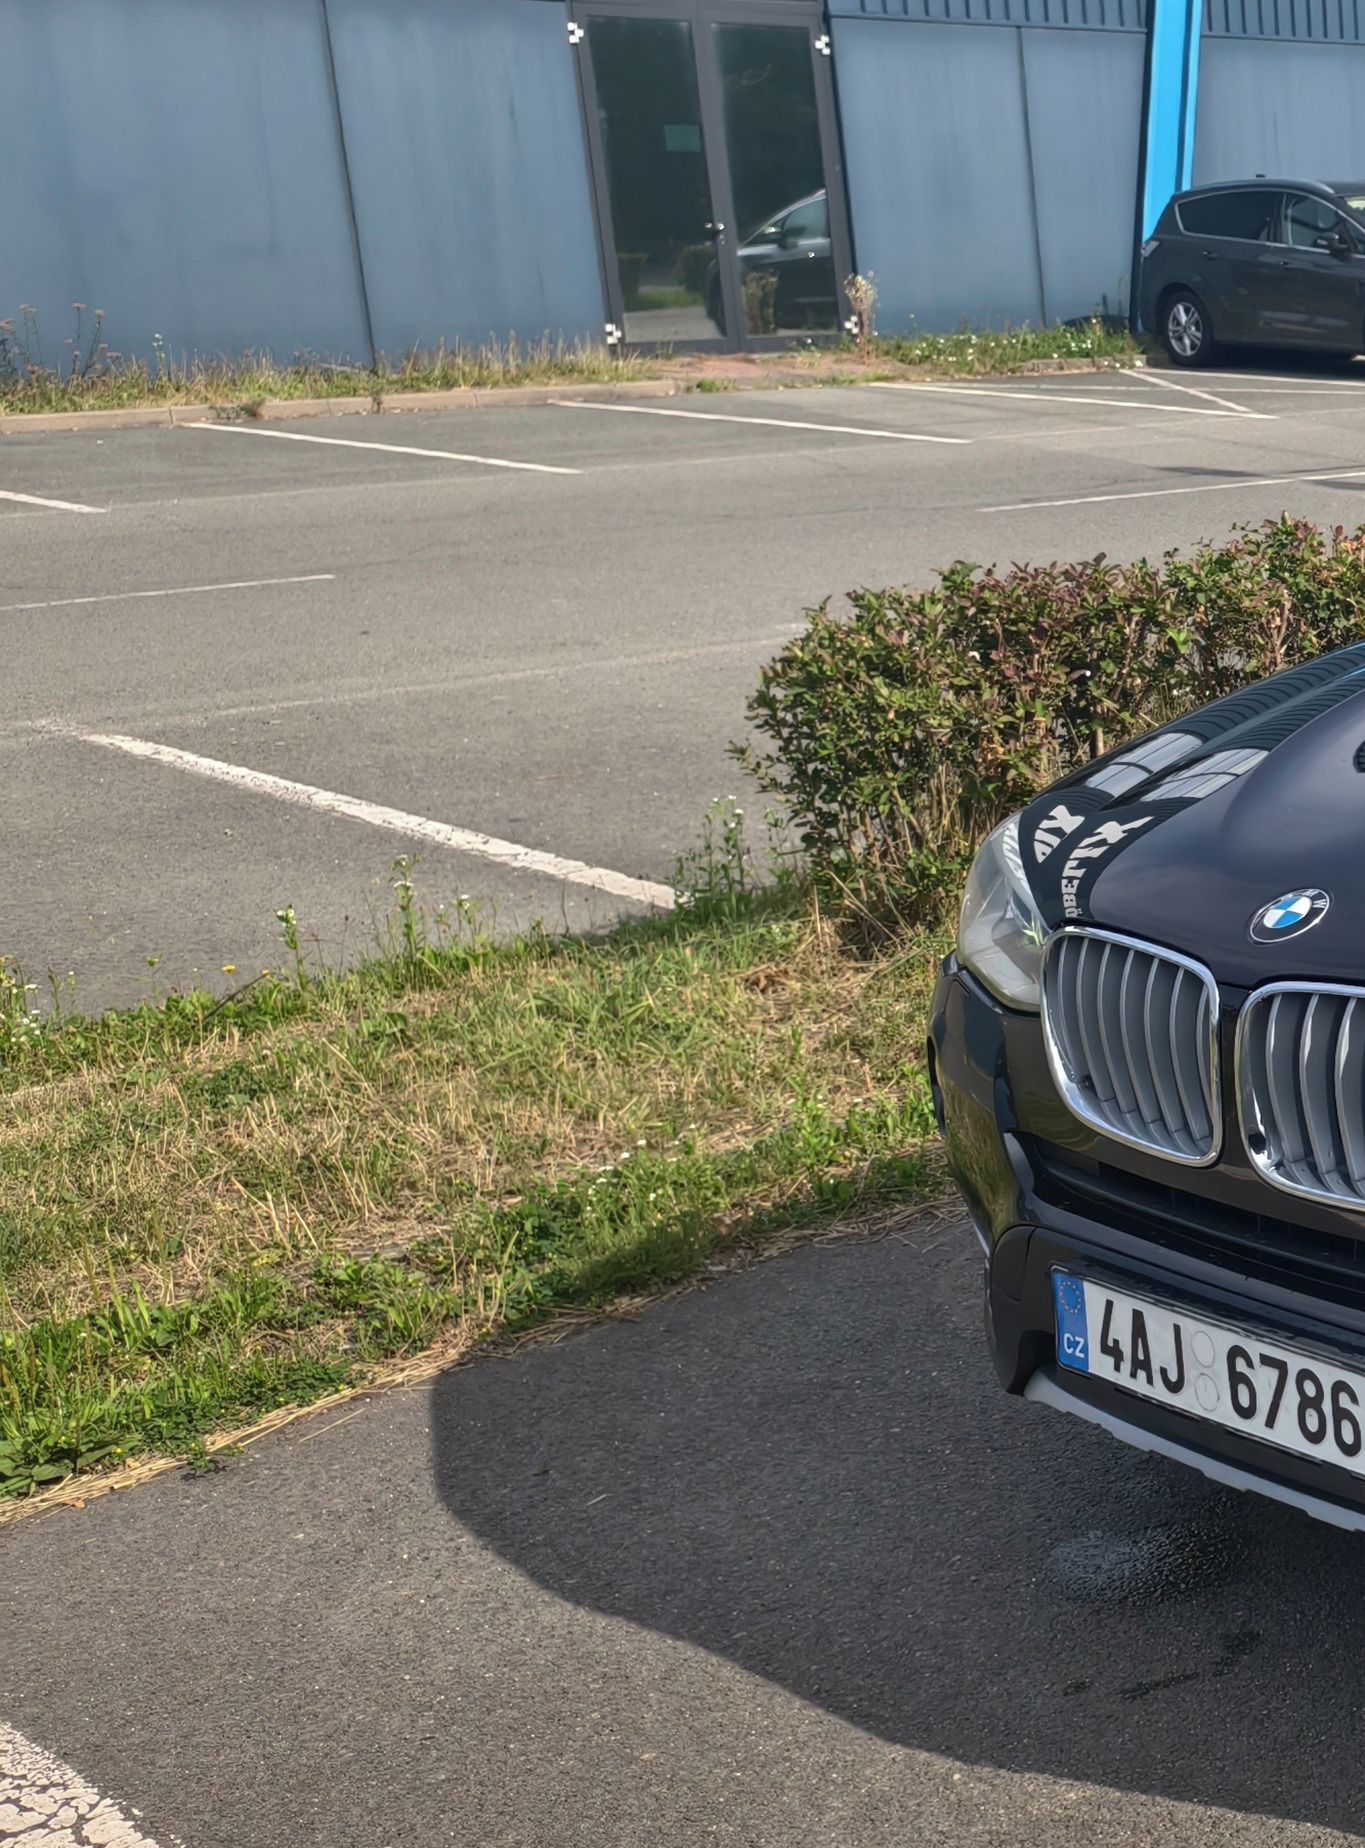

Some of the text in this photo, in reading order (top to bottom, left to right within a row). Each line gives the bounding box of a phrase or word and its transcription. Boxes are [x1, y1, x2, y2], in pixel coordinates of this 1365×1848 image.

[1063, 1331, 1085, 1359] CZ
[1099, 1298, 1363, 1458] 4AJ 6786
